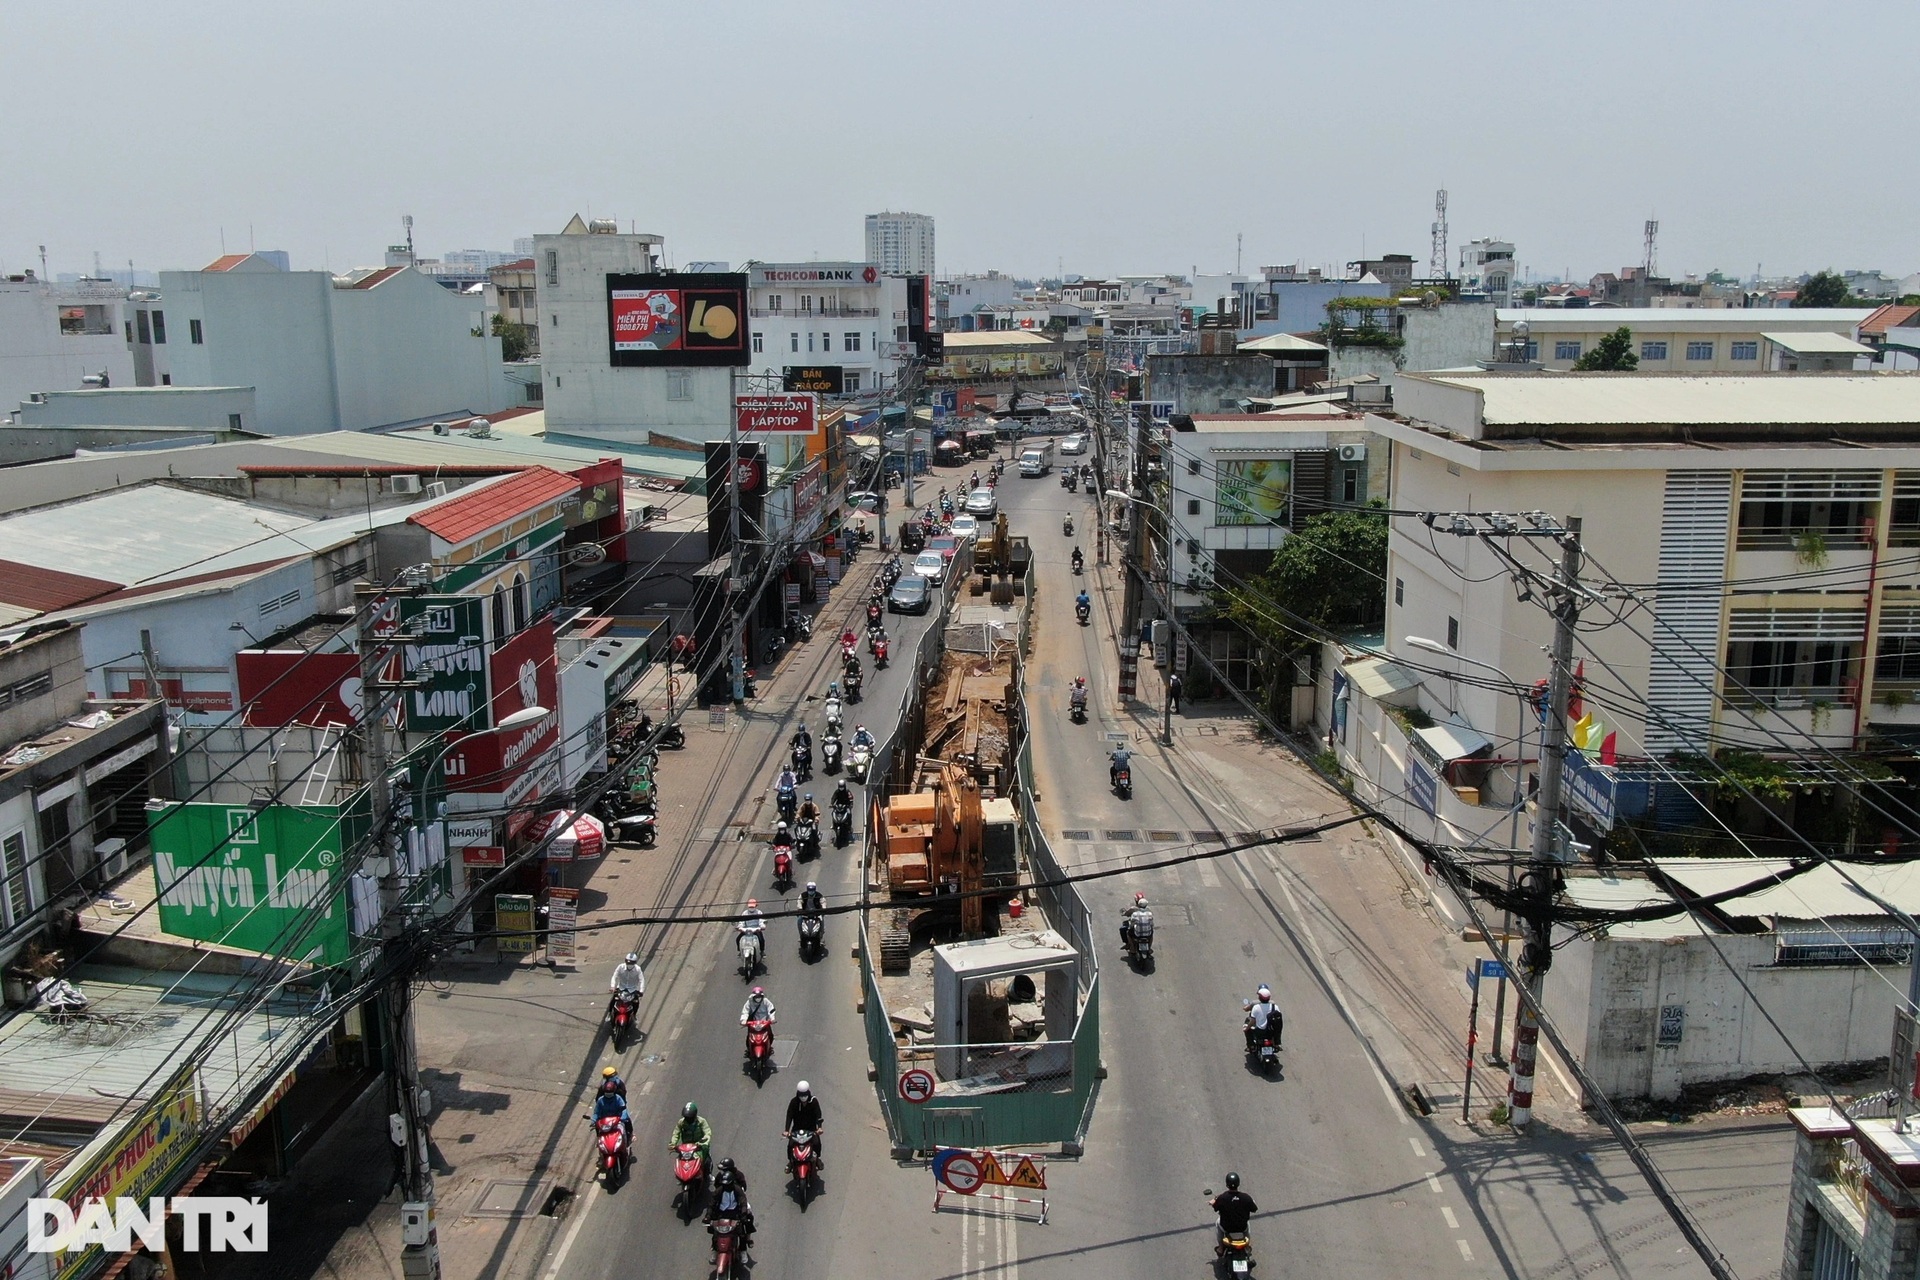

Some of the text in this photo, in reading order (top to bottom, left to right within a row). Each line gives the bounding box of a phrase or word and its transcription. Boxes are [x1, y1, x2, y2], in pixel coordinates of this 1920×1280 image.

[764, 270, 853, 281] TECHCOMBANK
[802, 369, 822, 378] BÁN
[812, 380, 832, 390] GÓP
[751, 416, 799, 426] LAPTOP
[449, 828, 488, 837] NHANH
